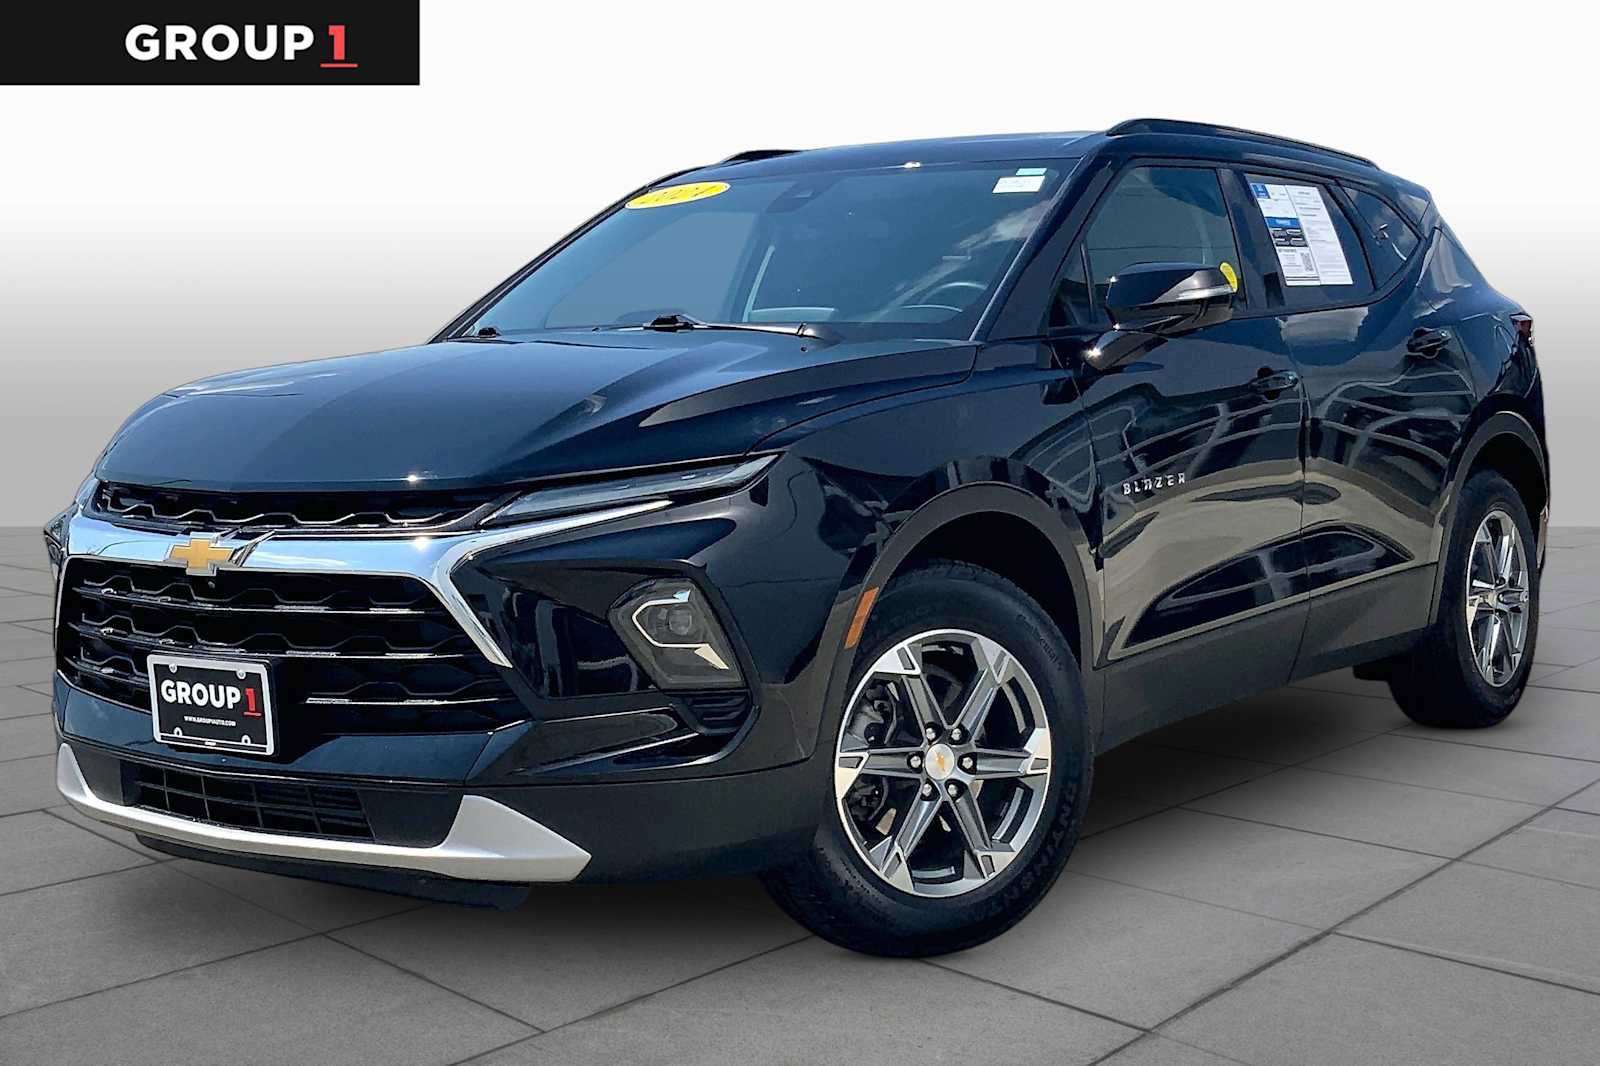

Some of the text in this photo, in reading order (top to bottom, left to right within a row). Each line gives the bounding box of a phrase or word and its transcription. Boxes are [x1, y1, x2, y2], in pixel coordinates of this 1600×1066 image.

[1122, 472, 1185, 495] BLAZER
[161, 679, 258, 714] GROUP 1
